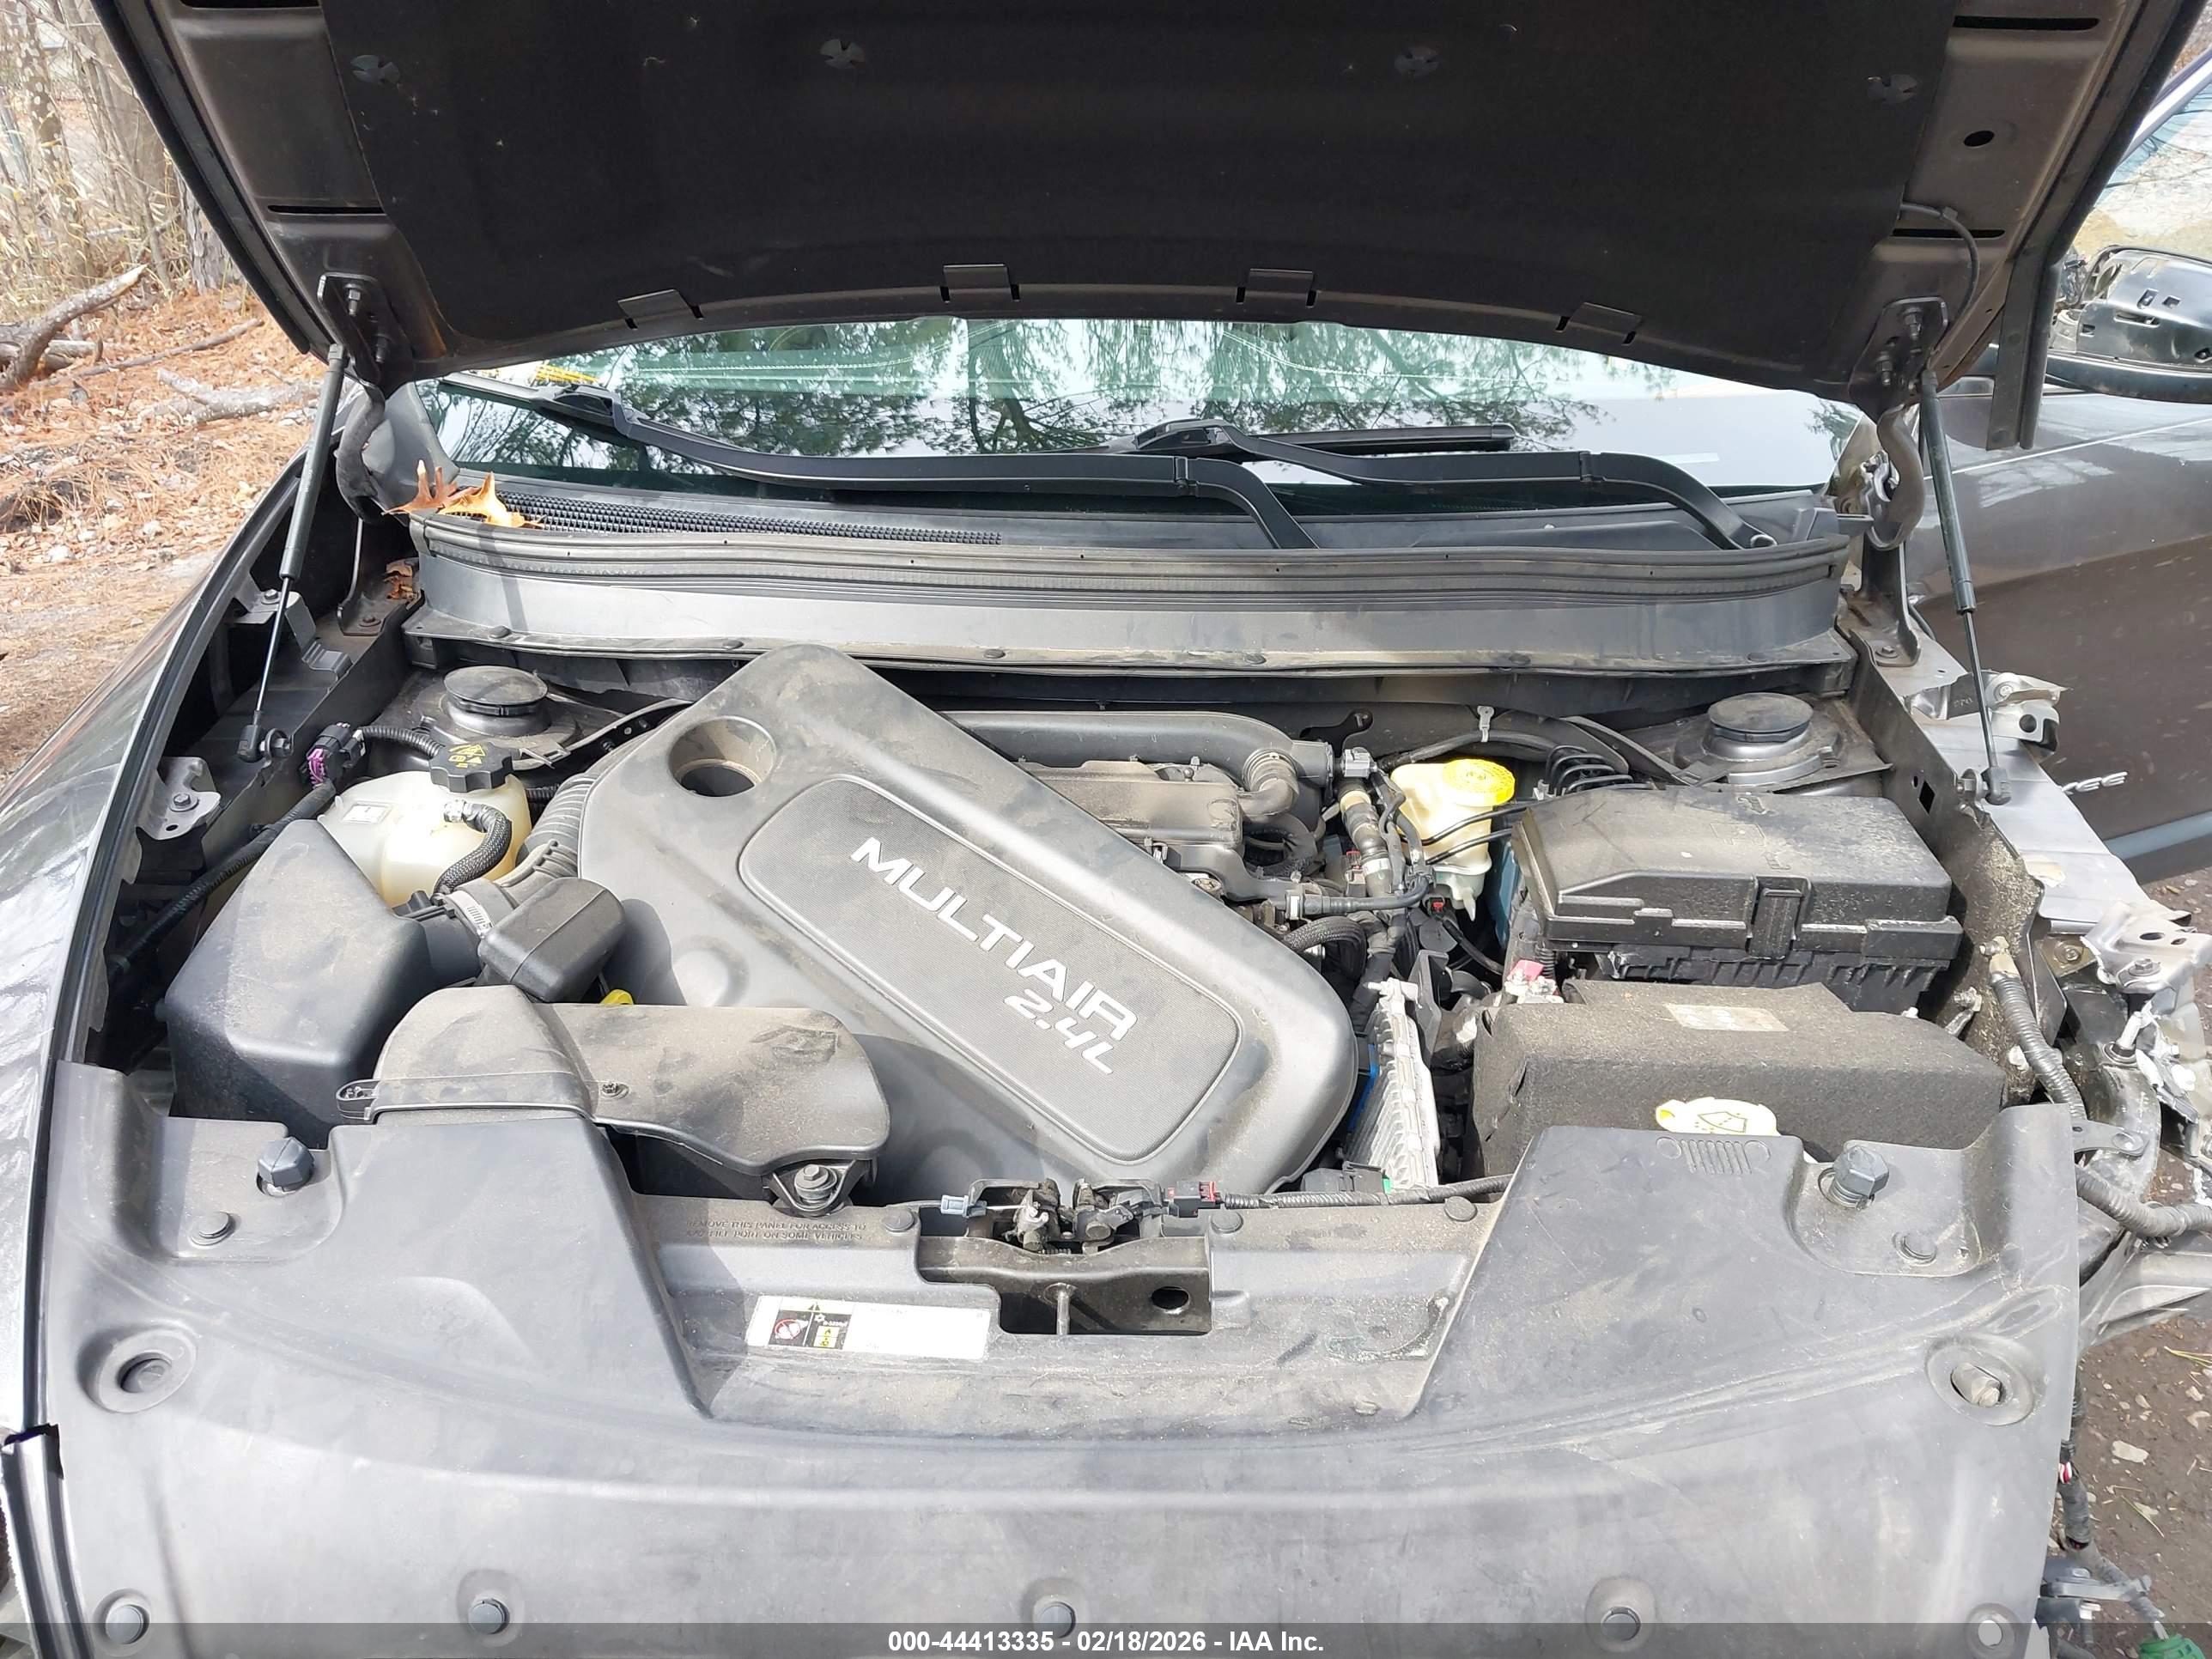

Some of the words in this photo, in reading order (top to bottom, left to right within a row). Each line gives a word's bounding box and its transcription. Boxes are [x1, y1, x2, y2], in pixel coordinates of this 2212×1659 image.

[850, 836, 1139, 1042] MULTIAIR
[1004, 988, 1115, 1075] 2.4L
[686, 1220, 729, 1229] REMOVE
[731, 1220, 754, 1229] THIS
[755, 1220, 785, 1230] PANEL
[789, 1221, 810, 1231] FOR
[811, 1221, 851, 1231] ACCESS
[854, 1221, 867, 1231] TO
[733, 1229, 758, 1238] PORT
[763, 1230, 780, 1238] ON
[781, 1231, 810, 1240] SOME
